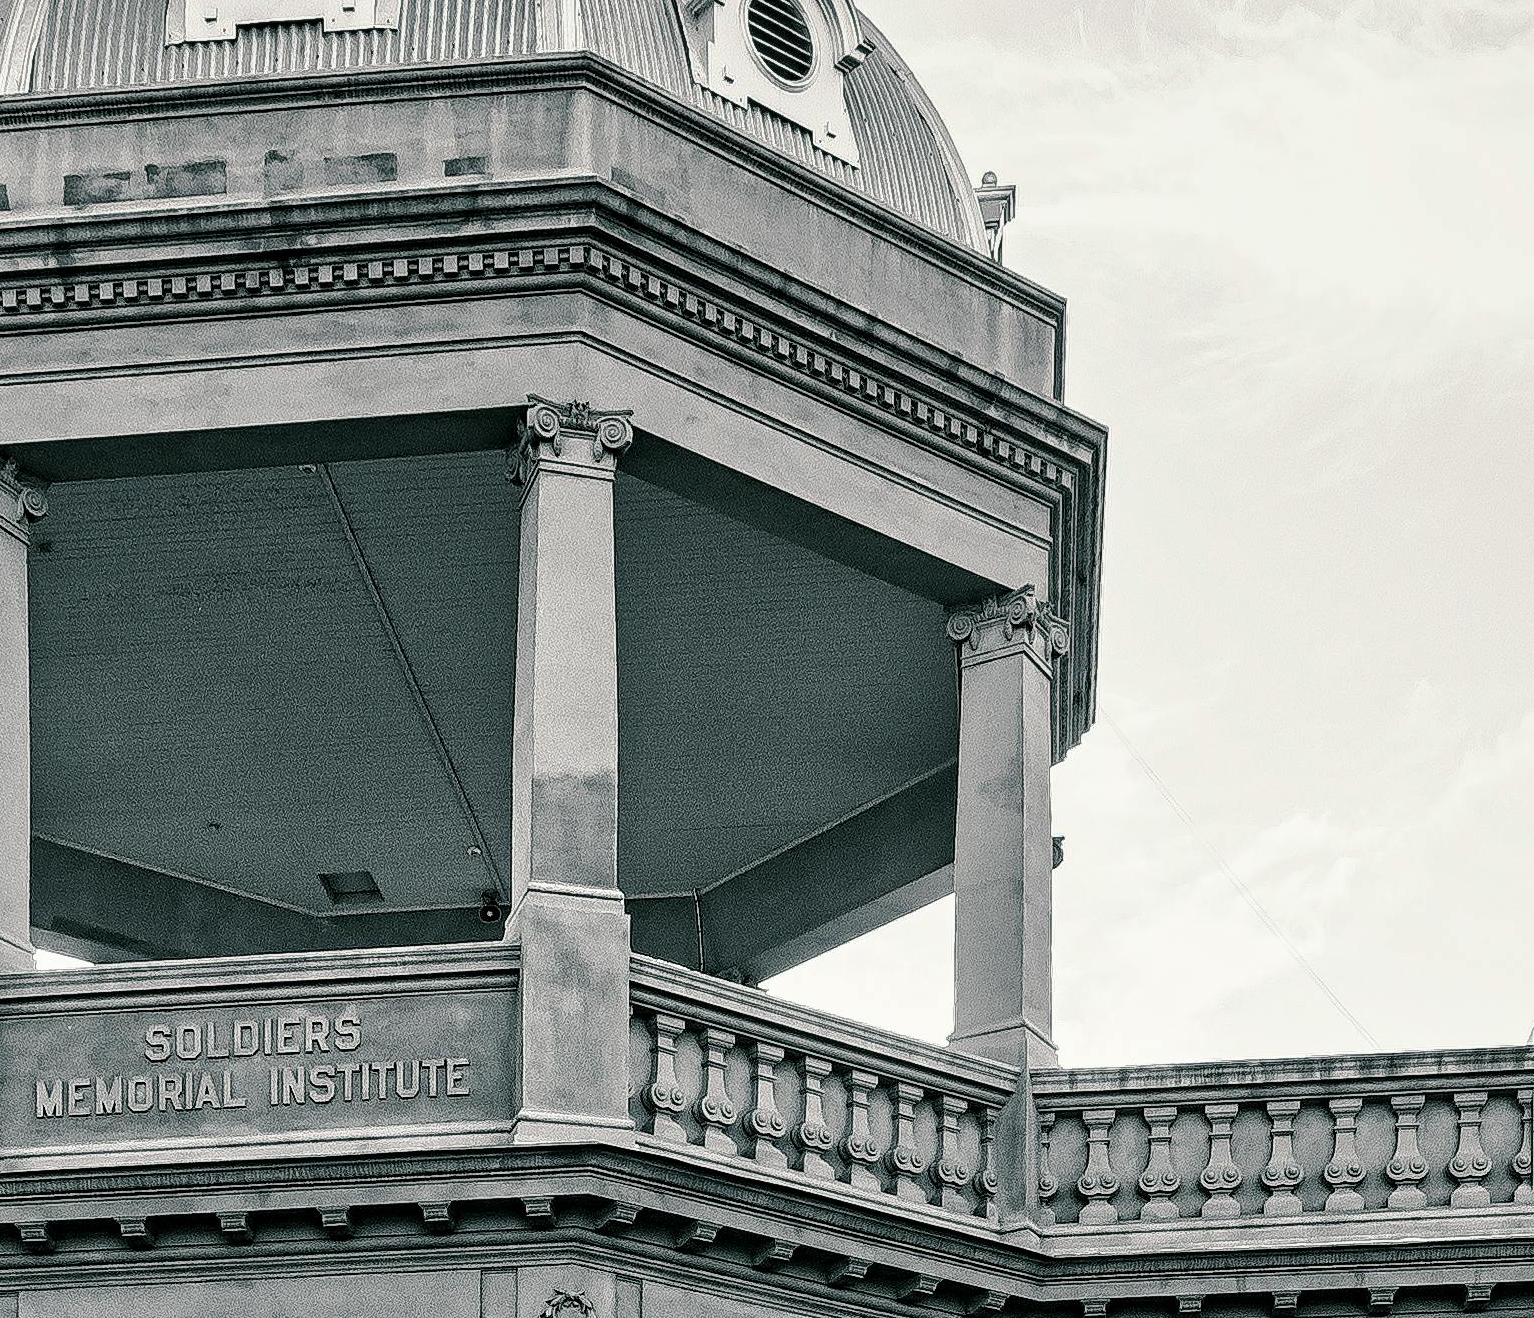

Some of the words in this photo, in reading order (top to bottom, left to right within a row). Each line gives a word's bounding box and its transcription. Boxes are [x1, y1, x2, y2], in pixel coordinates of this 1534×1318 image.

[145, 1013, 362, 1062] SOLDIERS
[35, 1072, 246, 1119] MEMORIAL
[269, 1058, 471, 1108] INSTITUTE
